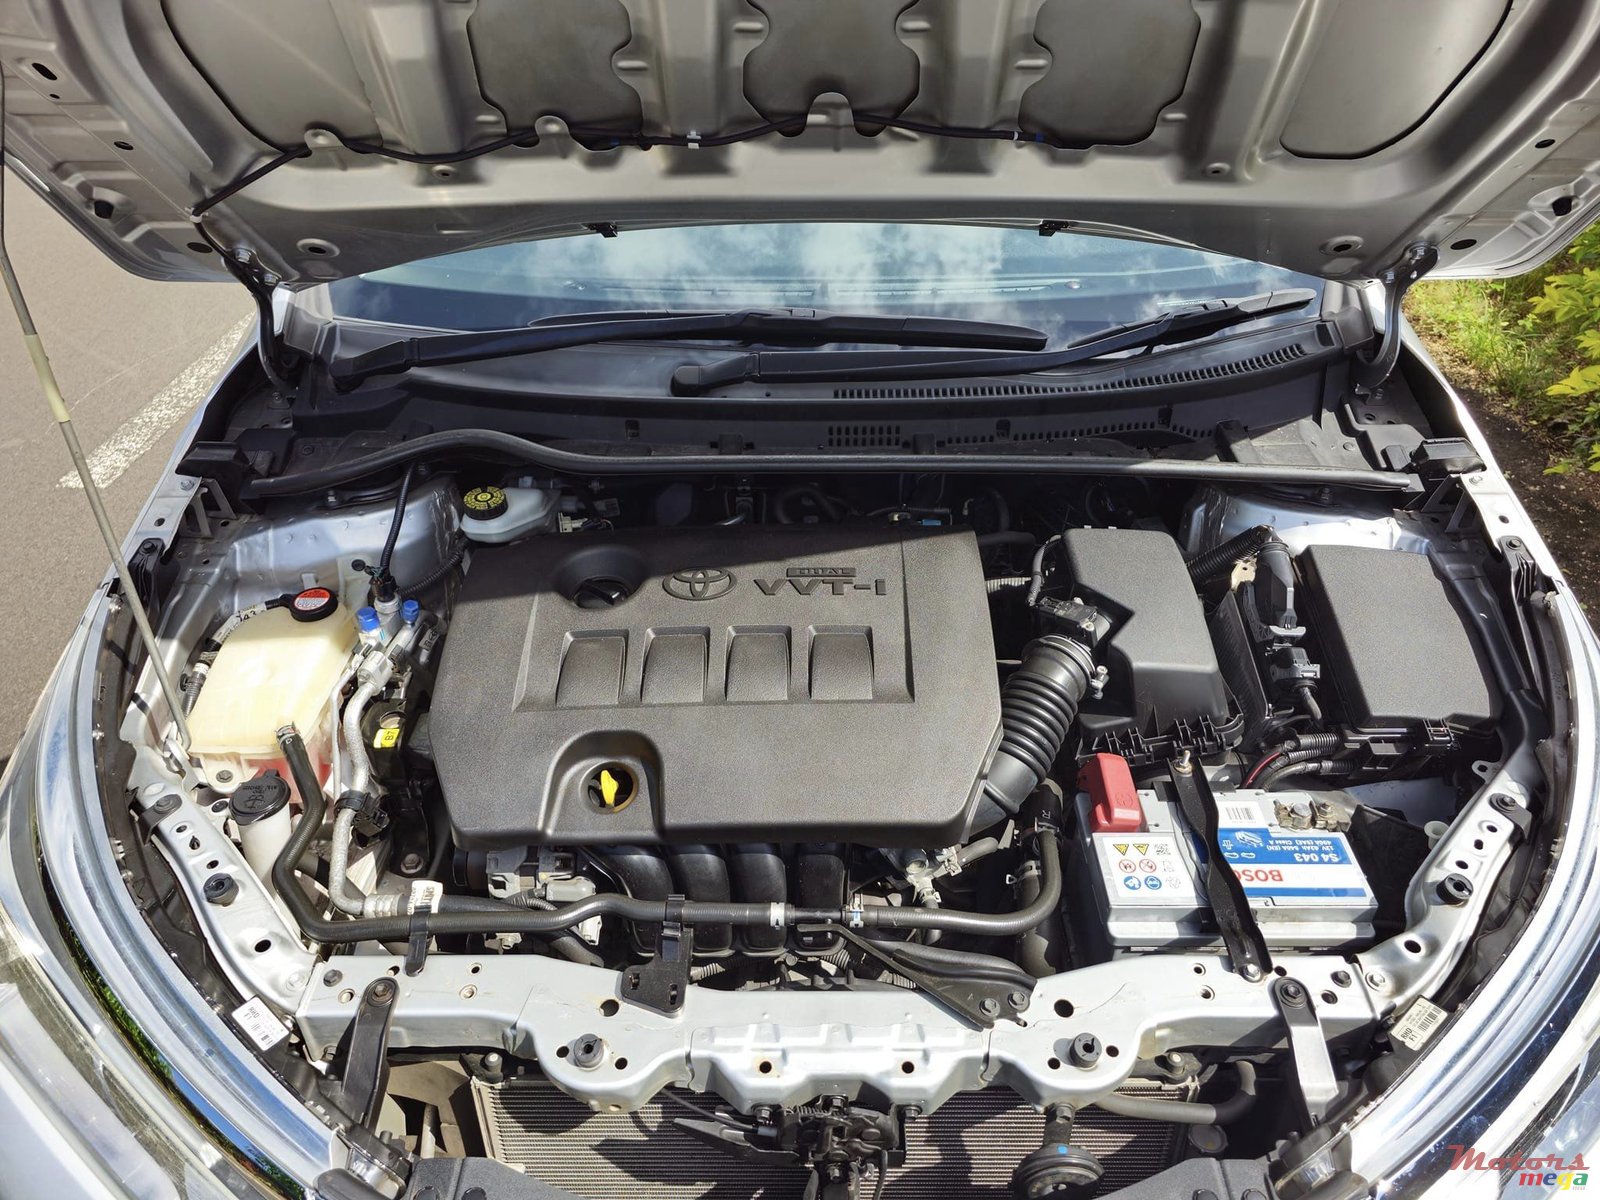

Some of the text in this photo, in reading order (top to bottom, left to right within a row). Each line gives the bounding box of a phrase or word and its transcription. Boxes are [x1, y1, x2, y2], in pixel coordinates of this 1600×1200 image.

[1294, 853, 1340, 862] S4 043
[1233, 869, 1283, 882] BOS
[1400, 1027, 1413, 1040] RHD
